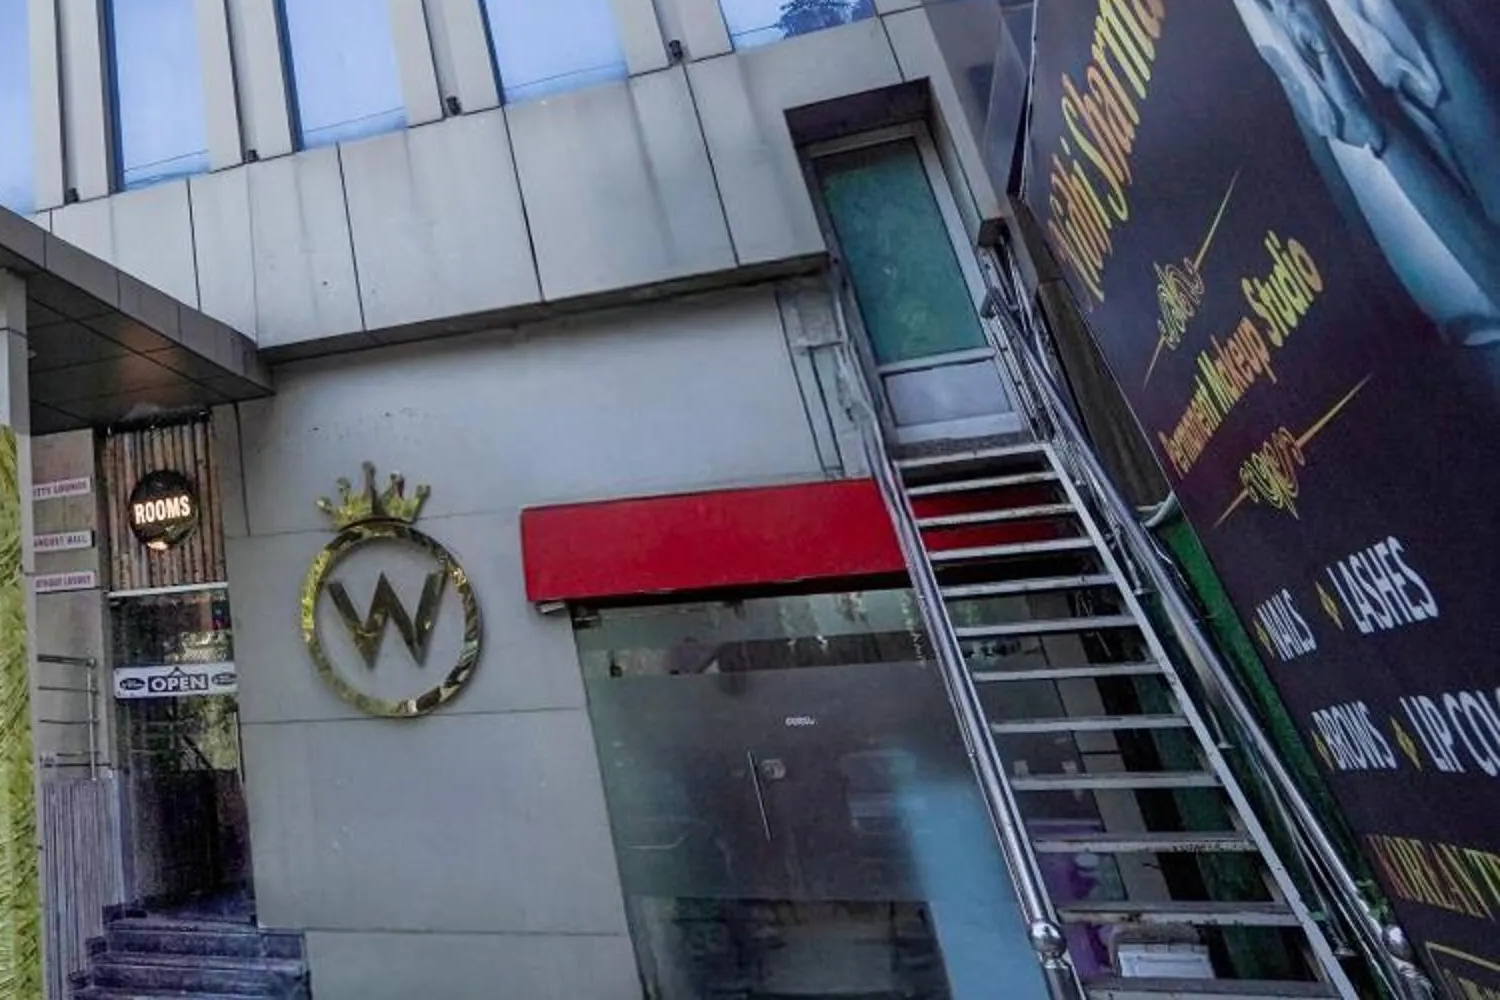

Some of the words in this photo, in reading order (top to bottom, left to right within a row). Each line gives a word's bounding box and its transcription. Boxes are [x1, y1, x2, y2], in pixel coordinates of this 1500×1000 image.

[1197, 316, 1277, 385] Makeup
[1241, 230, 1323, 347] Studio
[133, 494, 191, 525] ROOMS
[327, 571, 448, 669] W
[1255, 588, 1317, 662] NAILS
[1326, 535, 1439, 634] LASHES
[151, 674, 206, 691] OPEN
[1311, 700, 1397, 771] BROWS
[1400, 695, 1466, 774] LIP
